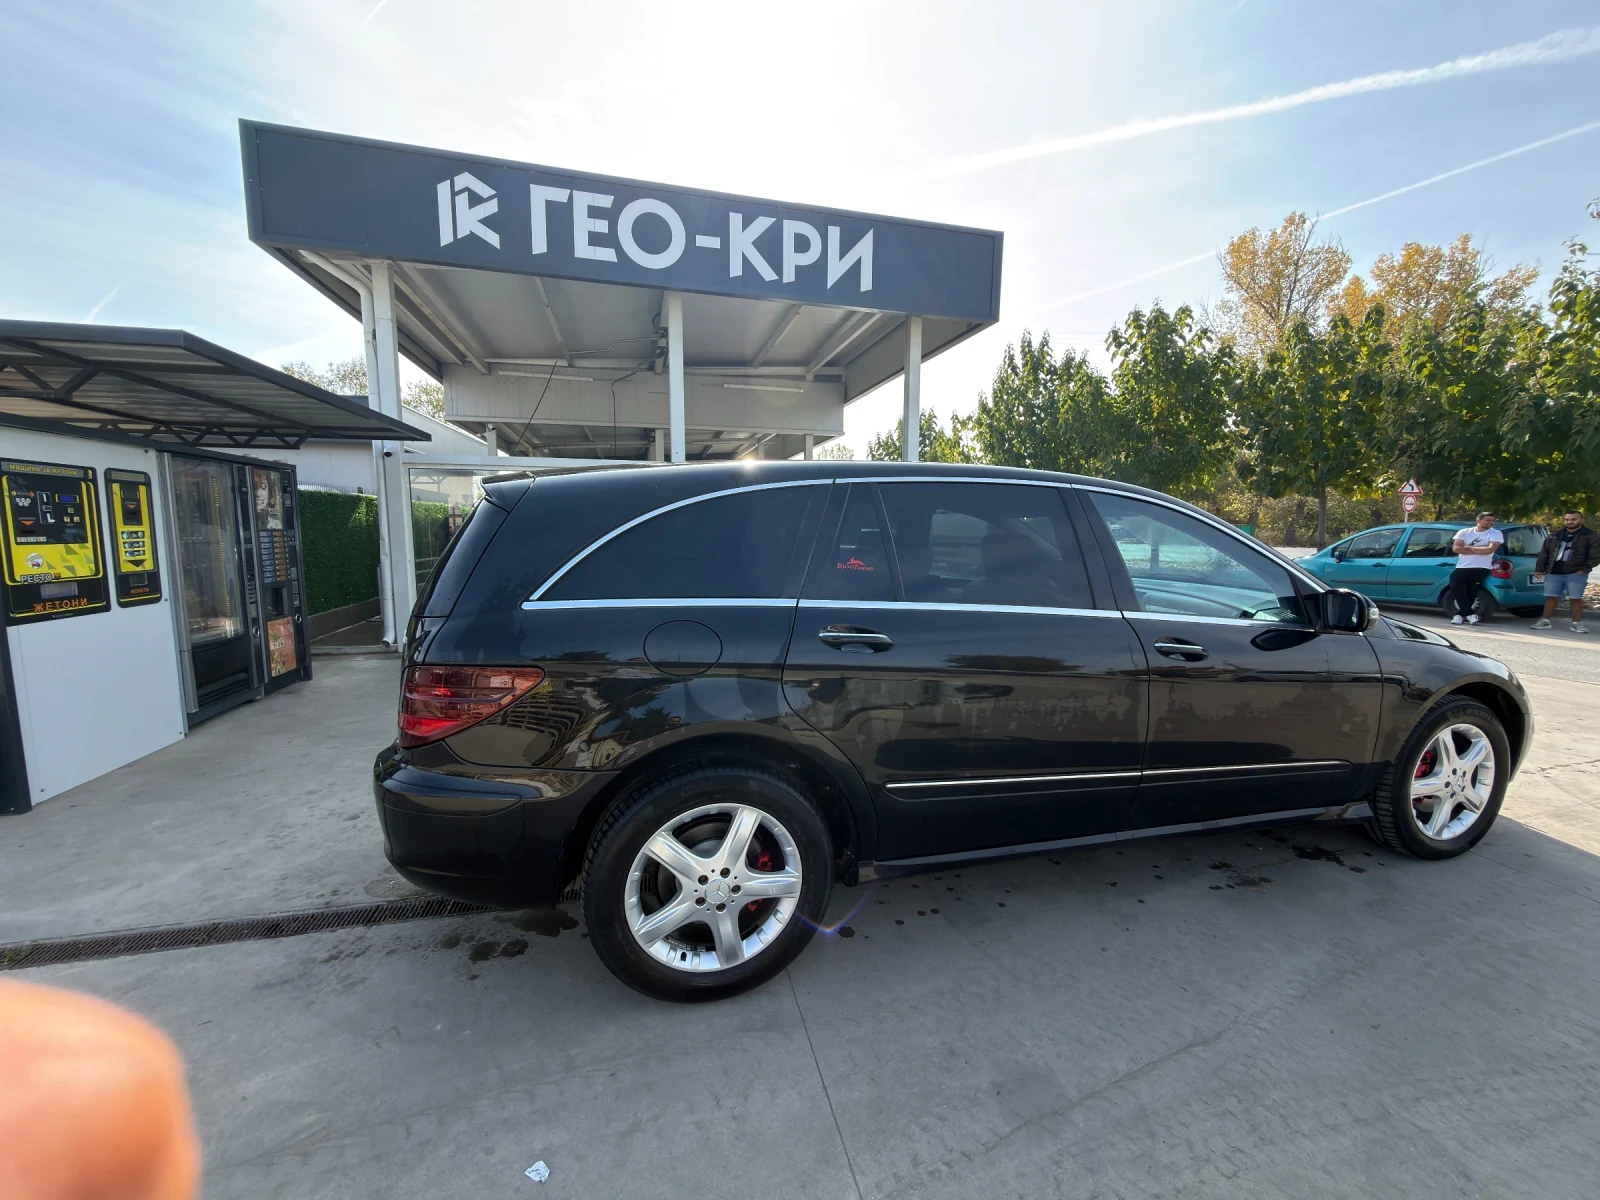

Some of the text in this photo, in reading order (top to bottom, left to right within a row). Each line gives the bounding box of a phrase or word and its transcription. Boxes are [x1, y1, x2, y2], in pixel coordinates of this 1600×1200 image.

[529, 183, 874, 292] ГЕО-КРИ
[21, 573, 53, 583] РЕСТО
[33, 598, 88, 613] ЖЕТОНИ
